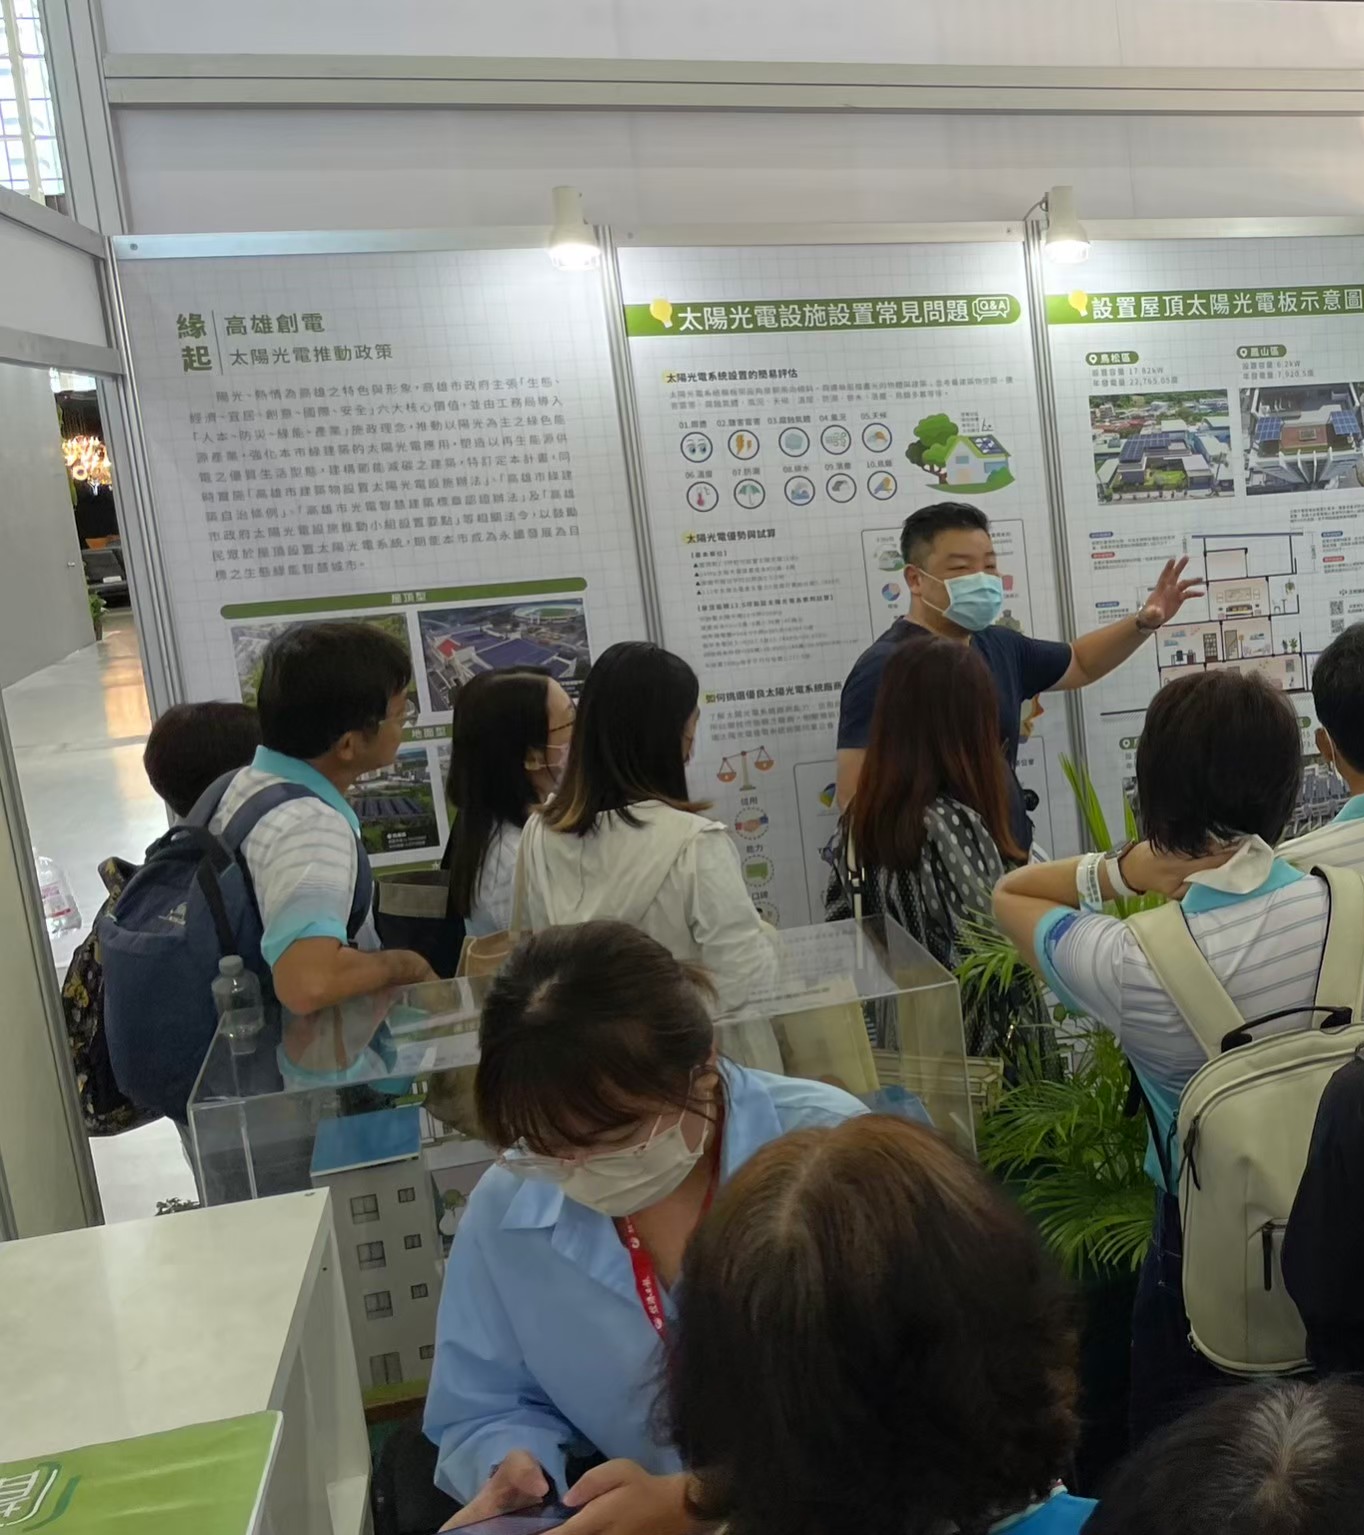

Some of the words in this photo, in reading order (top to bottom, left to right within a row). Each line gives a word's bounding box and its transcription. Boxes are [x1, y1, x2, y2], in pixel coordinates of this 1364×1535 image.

[677, 299, 969, 332] 太陽光電設施設置常見問題
[1092, 288, 1363, 320] 設置屋頂太陽光電板示意圖
[224, 312, 325, 337] 高雄創電
[229, 343, 394, 368] 太陽光電推動政策
